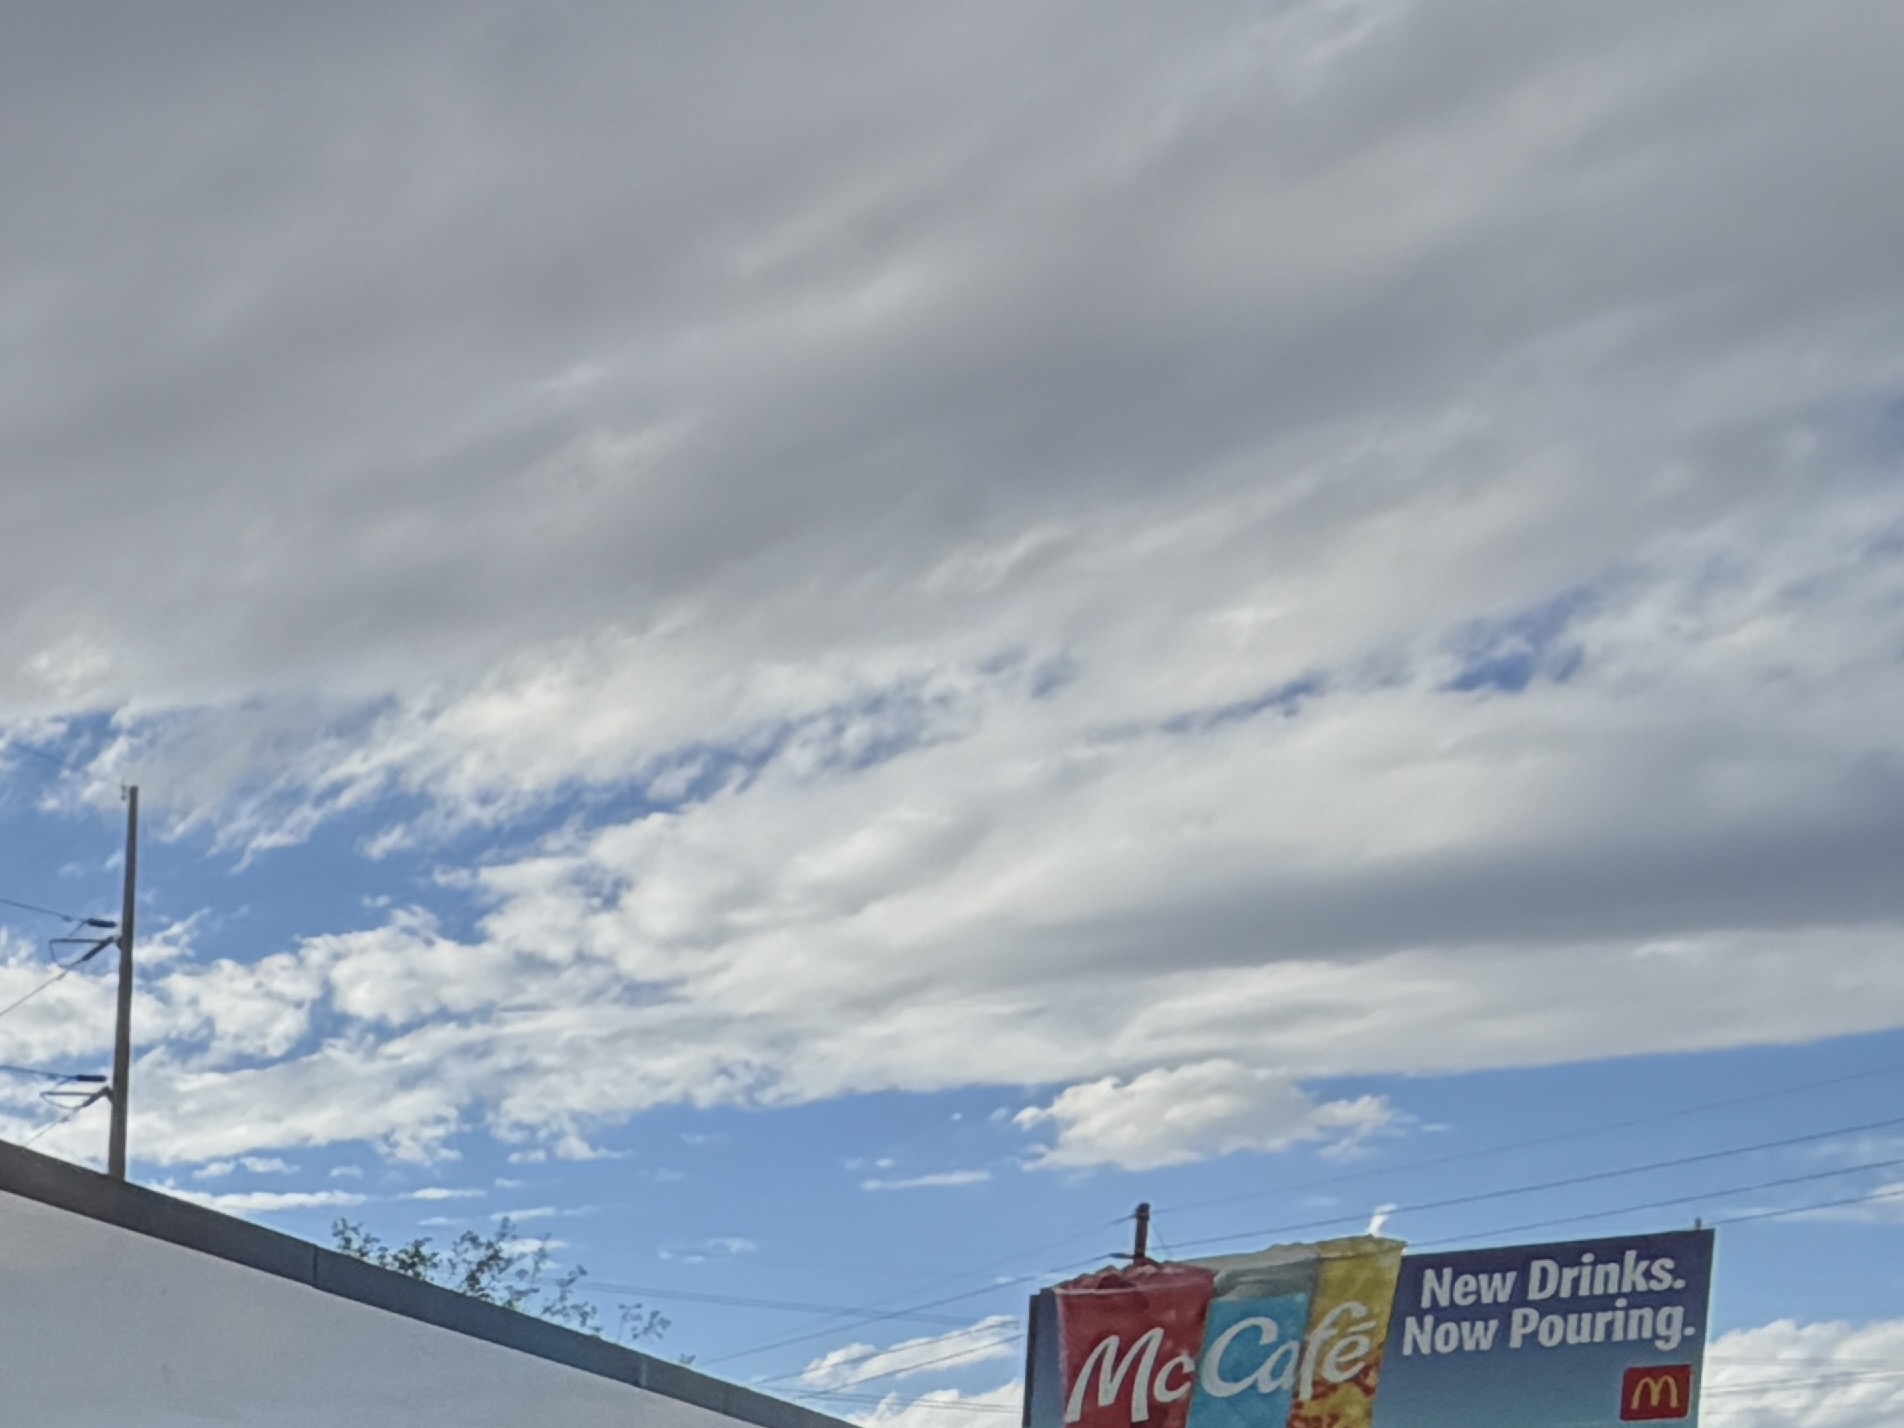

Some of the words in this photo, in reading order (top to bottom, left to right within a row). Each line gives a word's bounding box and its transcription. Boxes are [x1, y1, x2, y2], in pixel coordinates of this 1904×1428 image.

[1421, 1266, 1517, 1309] New
[1527, 1250, 1686, 1301] Drinks.
[1402, 1314, 1498, 1355] Now
[1508, 1298, 1696, 1351] Pouring.
[1064, 1301, 1377, 1424] McCafé
